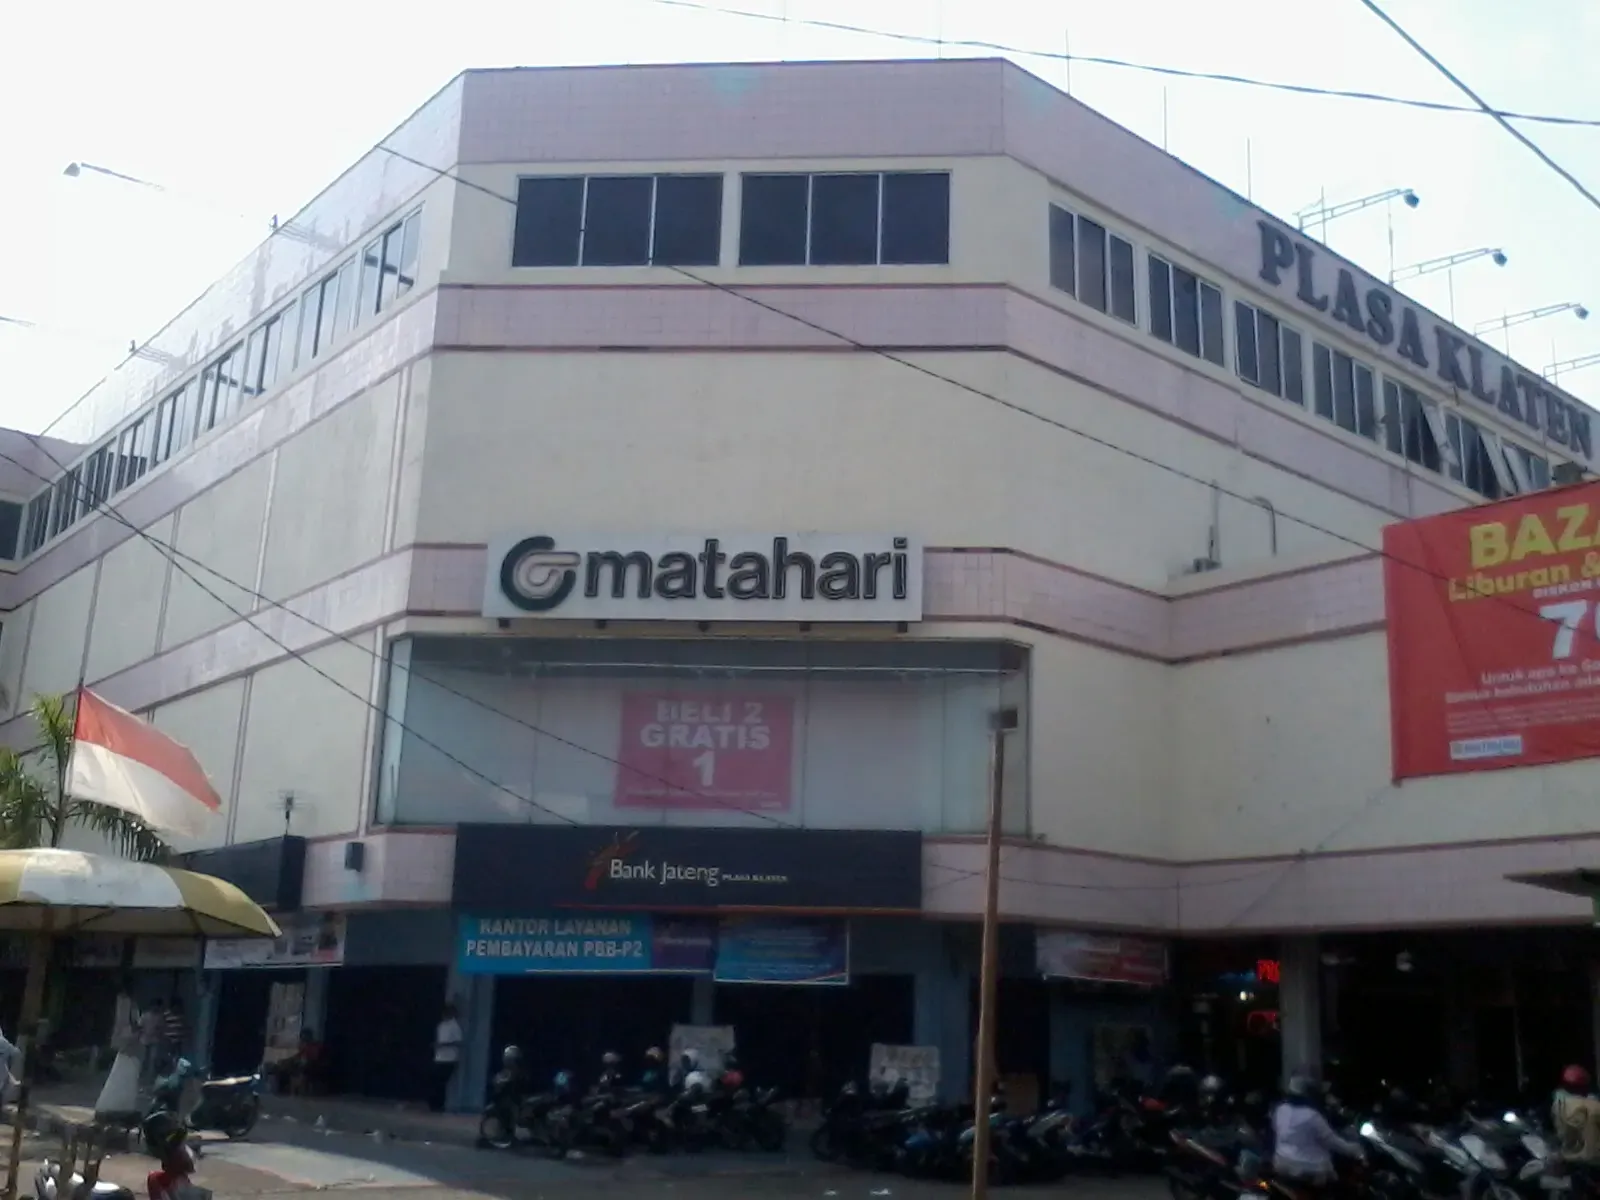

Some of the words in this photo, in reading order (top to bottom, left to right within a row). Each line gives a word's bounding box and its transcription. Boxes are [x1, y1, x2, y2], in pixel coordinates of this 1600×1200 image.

[1257, 220, 1429, 369] PLASA
[1434, 324, 1592, 460] KLATEN
[1470, 503, 1600, 569] BAZ
[583, 537, 908, 600] matahari
[1448, 564, 1570, 602] Liburan
[1540, 599, 1600, 660] 7
[657, 700, 732, 723] BELI
[743, 701, 763, 724] 2
[640, 723, 771, 750] GRATIS
[692, 750, 715, 787] 1
[610, 858, 656, 880] Bank
[660, 861, 721, 888] Jateng
[480, 918, 549, 936] KANTOR
[555, 918, 632, 936] LAYANAN
[466, 939, 579, 958] PEMBAYARAN
[583, 940, 644, 958] PBB-P2
